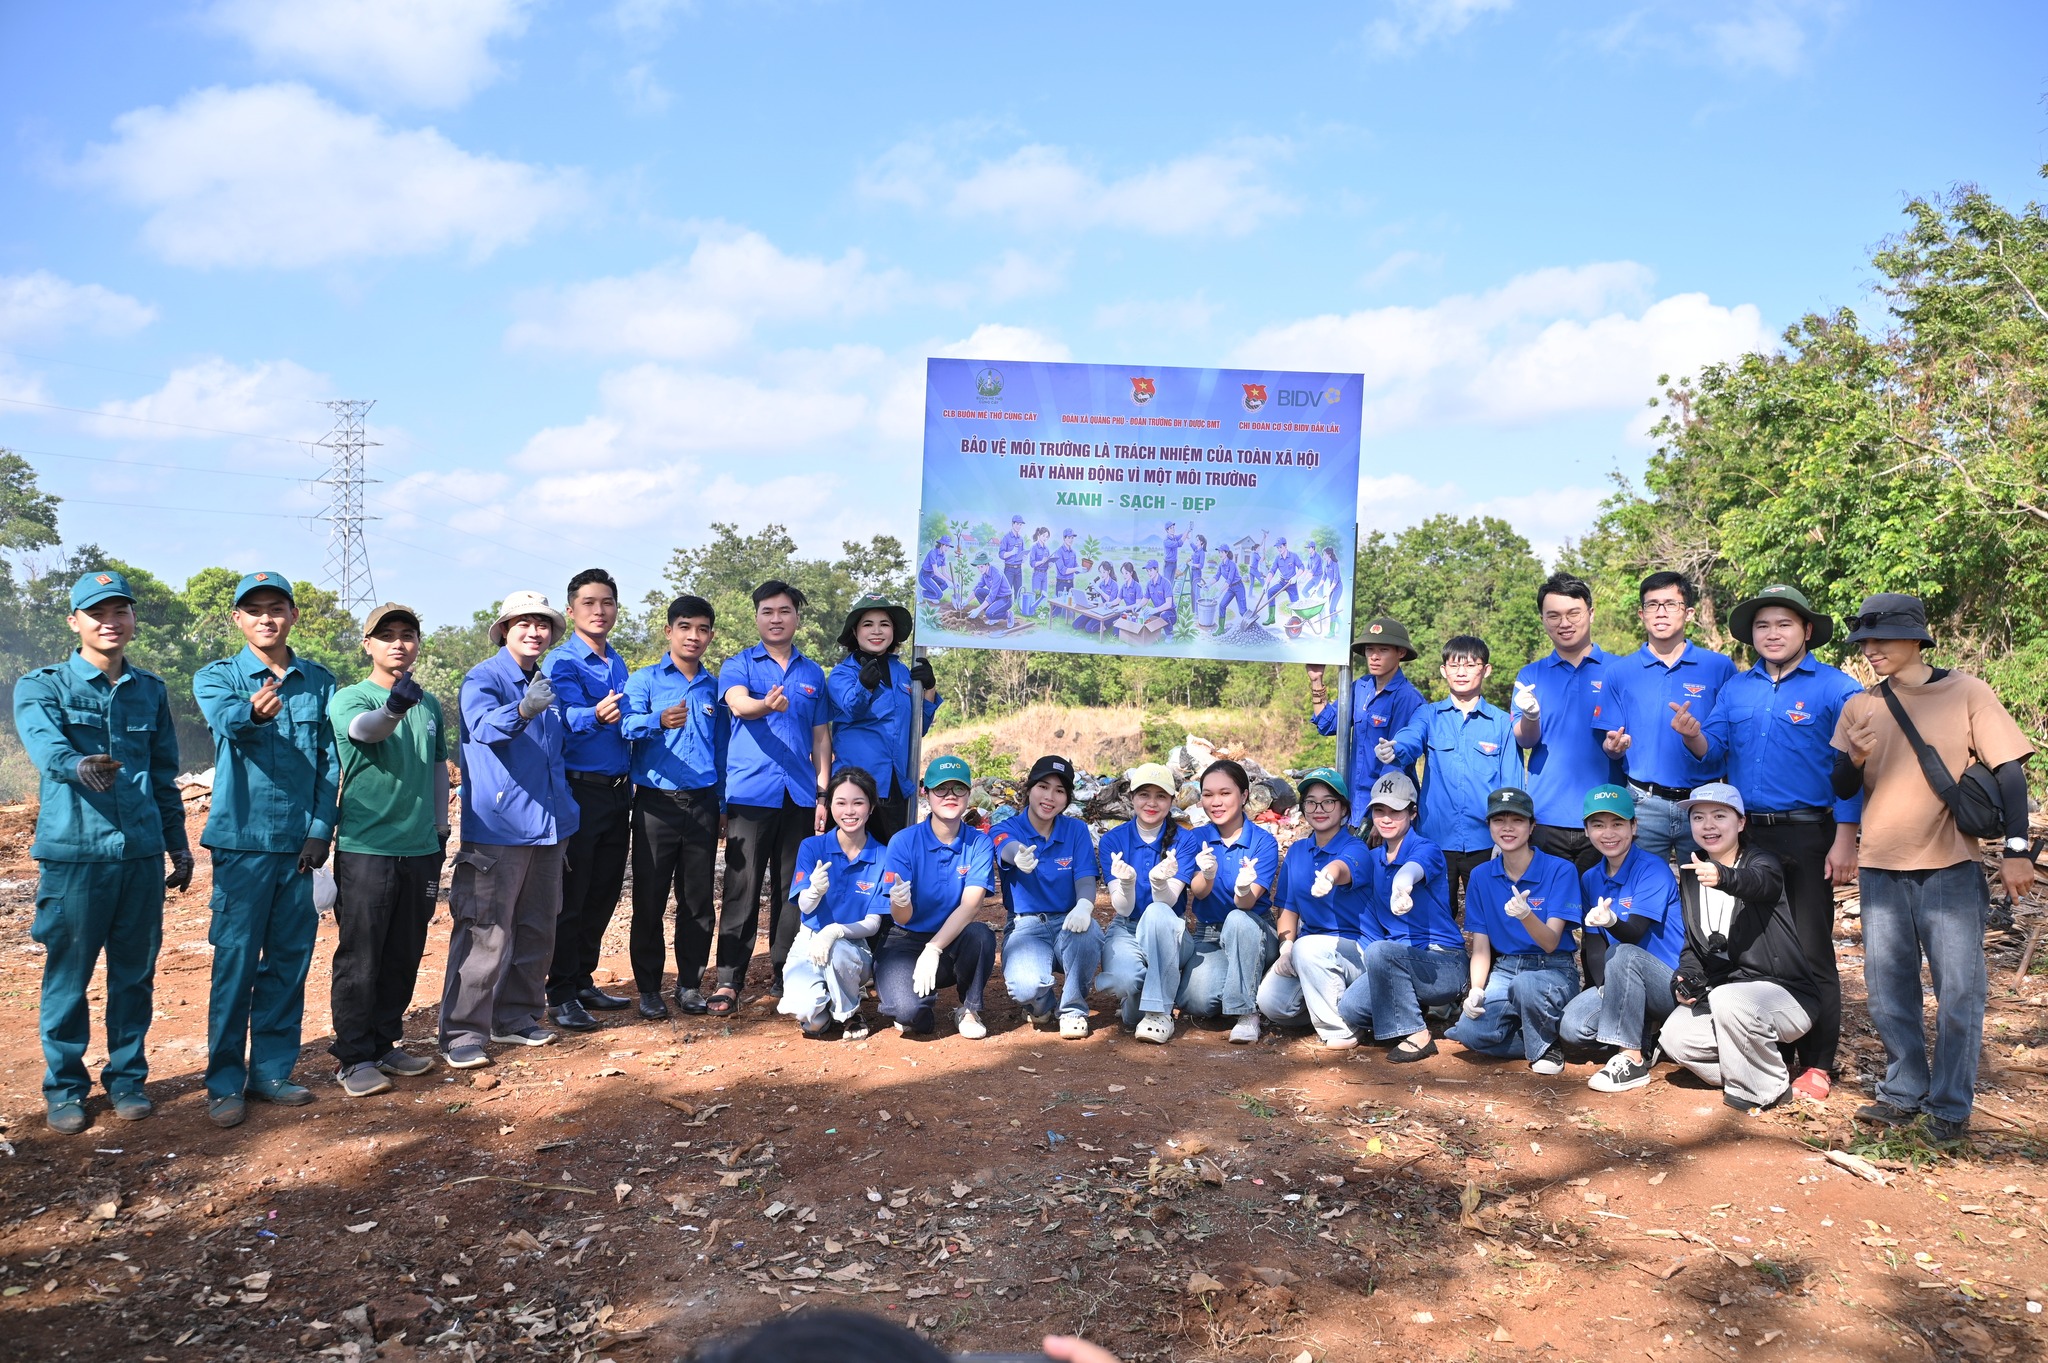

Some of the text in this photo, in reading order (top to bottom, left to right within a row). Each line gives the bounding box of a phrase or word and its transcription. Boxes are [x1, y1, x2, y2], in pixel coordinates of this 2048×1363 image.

[1278, 390, 1324, 407] BIDV
[943, 409, 956, 418] CLB
[957, 409, 976, 419] BUÔN
[1183, 419, 1188, 428] Y
[1207, 420, 1220, 429] BMT
[1239, 421, 1251, 430] CHI
[1294, 423, 1309, 432] BIDV
[961, 434, 1320, 469] BẢO VỆ MÔI TRƯỜNG LÀ TRÁCH NHIỆM CỦA TOÀN XÃ HỘI
[1020, 462, 1257, 487] HÃY HÀNH ĐỘNG VÌ MỘT MÔI TRƯỜNG
[1056, 491, 1102, 507] XANH
[1120, 494, 1165, 511] SẠCH
[1182, 496, 1216, 514] ĐẸP
[940, 762, 956, 770] BIDV
[1501, 792, 1514, 802] F
[1594, 791, 1612, 800] BIDV
